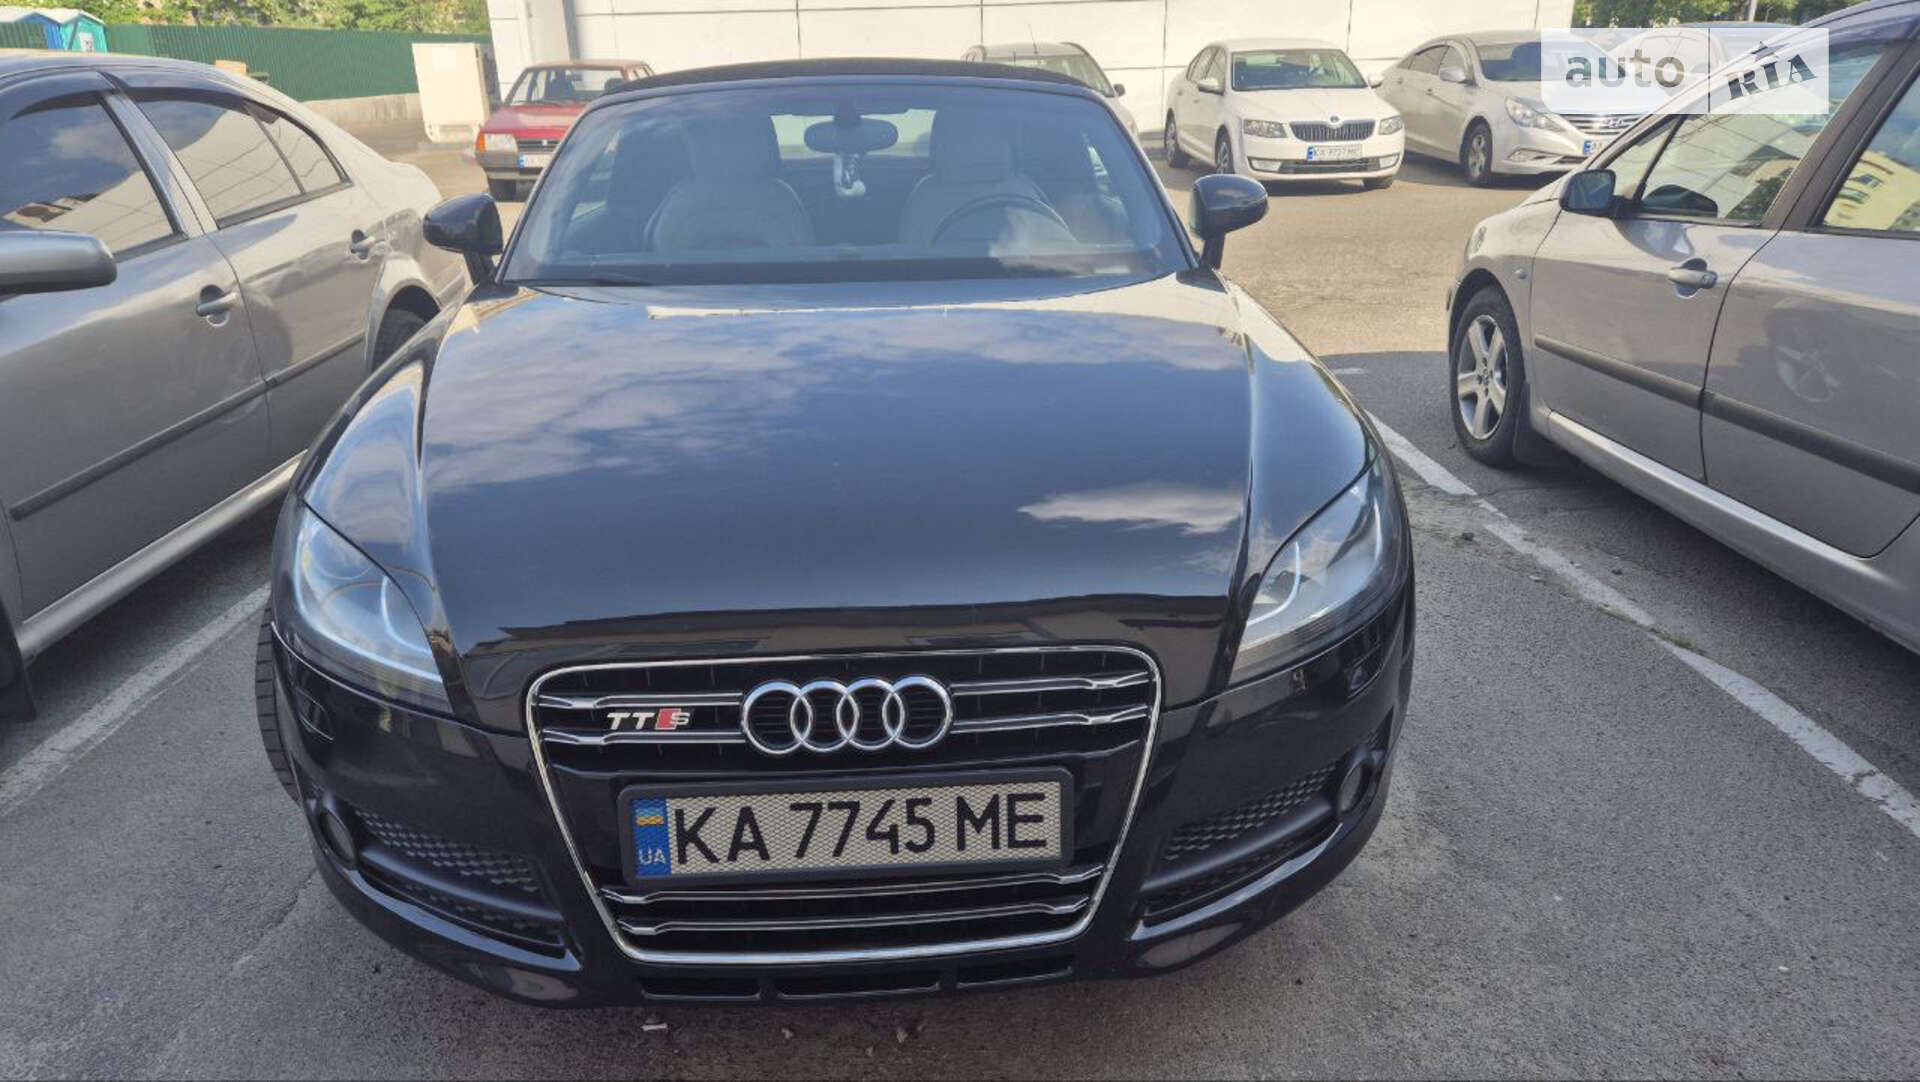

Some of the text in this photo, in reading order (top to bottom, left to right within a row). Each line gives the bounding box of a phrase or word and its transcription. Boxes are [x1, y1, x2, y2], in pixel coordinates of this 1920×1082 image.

[607, 711, 691, 730] TTS
[674, 793, 1048, 865] KA 7745 ME
[638, 847, 667, 866] UA
